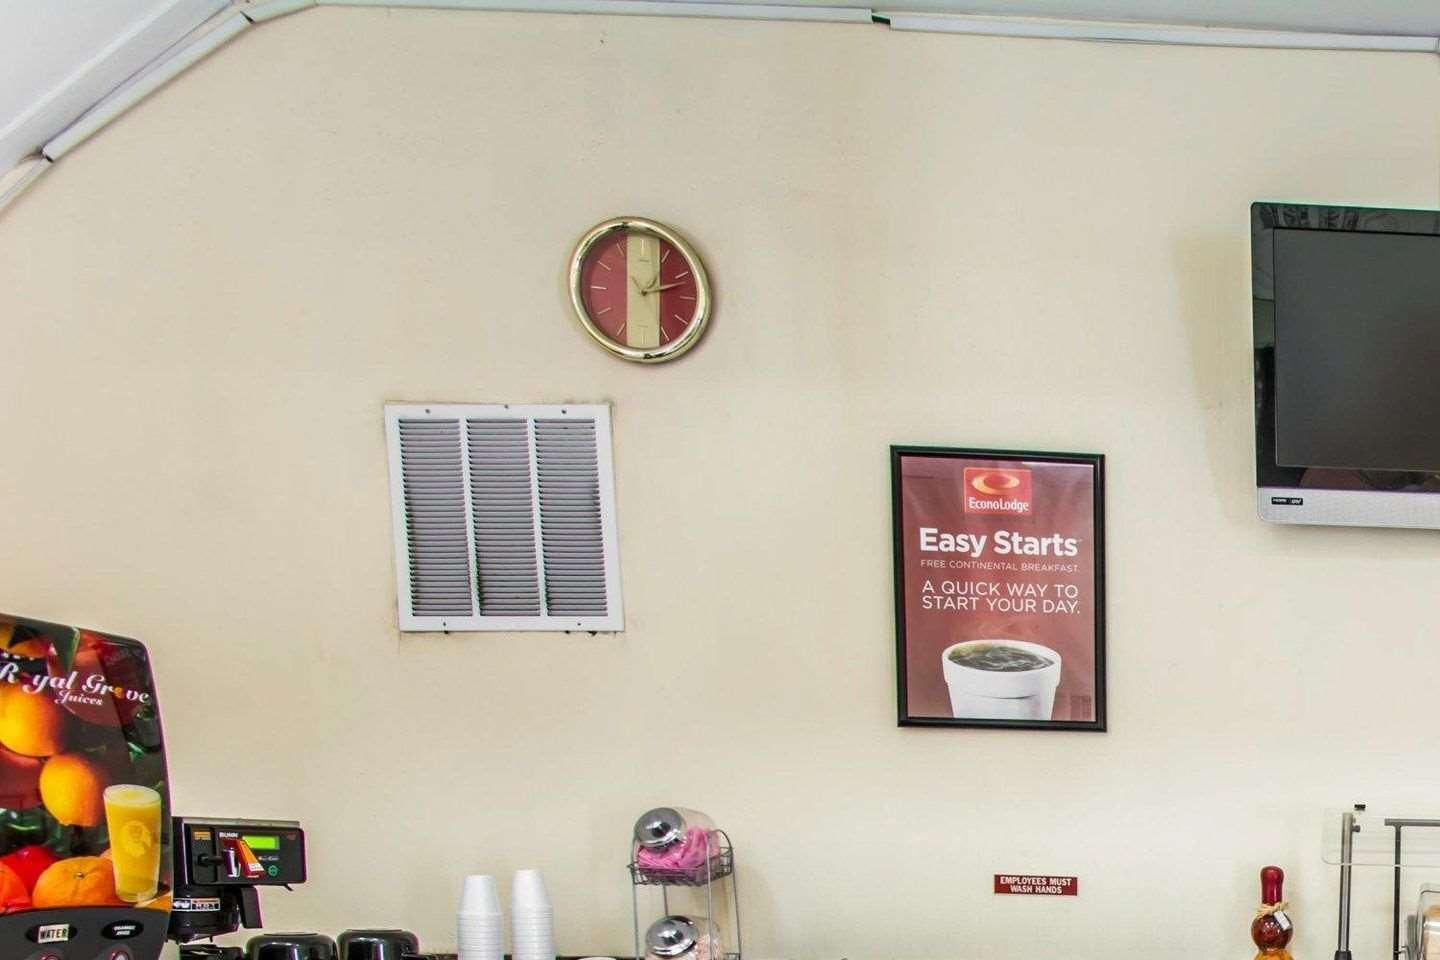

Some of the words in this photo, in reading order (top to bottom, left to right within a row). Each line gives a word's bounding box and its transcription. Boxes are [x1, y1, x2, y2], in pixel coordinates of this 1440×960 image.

[968, 496, 1030, 513] EconoLodge
[919, 527, 988, 557] Easy
[993, 530, 1079, 557] Starts
[920, 559, 946, 569] FREE
[949, 560, 1019, 571] CONTINENTAL
[922, 580, 935, 594] A
[941, 580, 1001, 596] QUICK
[1006, 582, 1048, 598] WAY
[1053, 584, 1079, 599] TO
[922, 595, 980, 611] START
[986, 597, 1037, 613] YOUR
[1042, 599, 1081, 614] DAY.
[999, 876, 1047, 885] EMPLOYEES
[1048, 877, 1072, 886] MUST
[1010, 885, 1033, 893] WASH
[1035, 885, 1063, 894] HANDS
[39, 928, 67, 940] WATER
